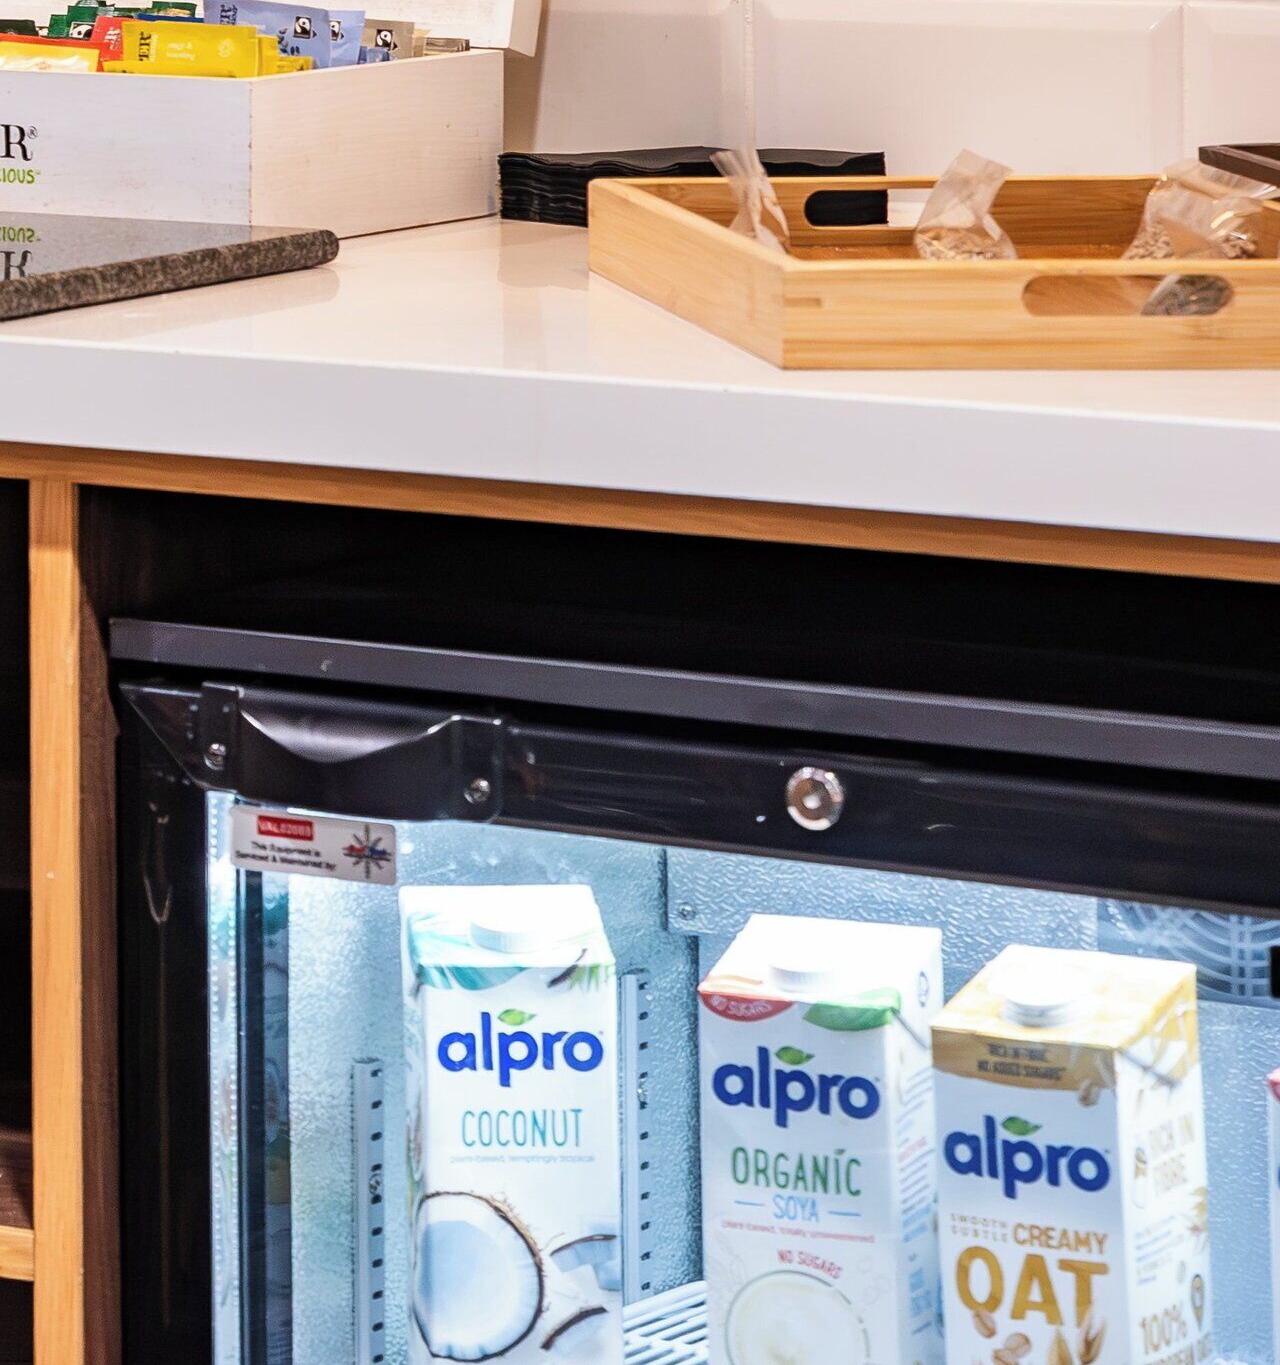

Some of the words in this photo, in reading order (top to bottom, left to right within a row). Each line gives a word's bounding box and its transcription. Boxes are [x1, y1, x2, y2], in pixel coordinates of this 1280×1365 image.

[437, 1011, 603, 1088] alpro
[713, 1045, 880, 1128] alpro
[462, 1108, 582, 1147] COCONUT
[944, 1114, 1110, 1199] alpro
[773, 1194, 819, 1222] SOYA
[777, 1249, 793, 1264] NO
[797, 1251, 843, 1279] SUGARS
[1013, 1223, 1109, 1255] CREAMY
[955, 1245, 1110, 1329] OAT
